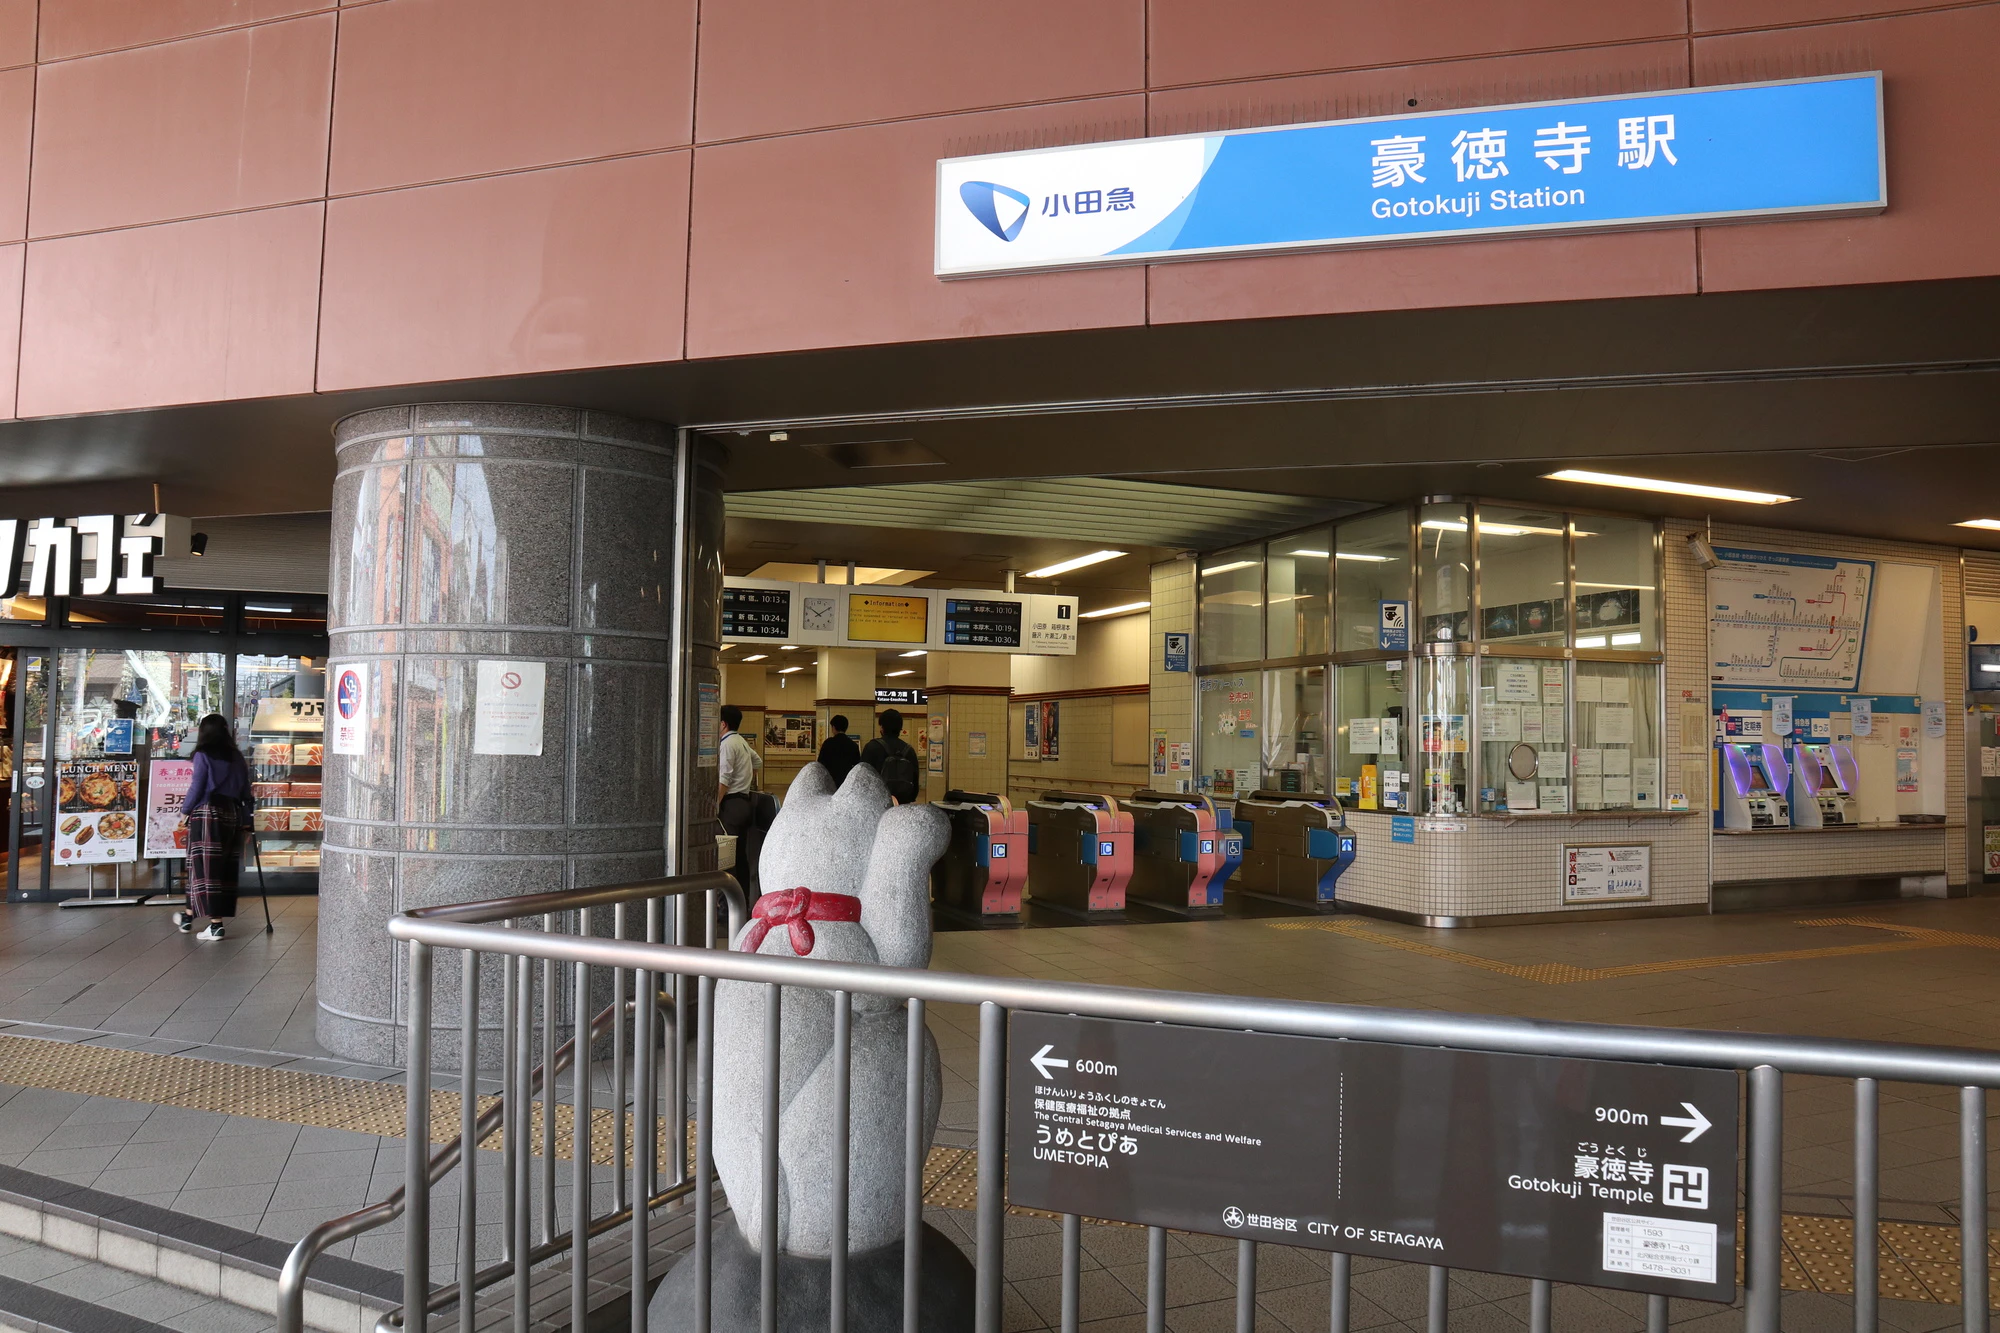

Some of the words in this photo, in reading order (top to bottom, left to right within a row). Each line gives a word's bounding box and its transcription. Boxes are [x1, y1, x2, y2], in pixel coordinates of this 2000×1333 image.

[1370, 114, 1678, 188] 豪徳寺駅
[1042, 187, 1136, 217] 小田急
[1371, 191, 1480, 219] Gotokuji
[1490, 187, 1585, 210] Station
[762, 595, 780, 603] 10:13
[761, 614, 780, 622] 10:24
[1061, 606, 1066, 618] 1
[761, 626, 780, 634] 10:34
[995, 624, 1012, 632] 10:19
[995, 636, 1012, 644] 10:30
[911, 690, 917, 704] 1
[1715, 719, 1721, 732] 1
[62, 765, 100, 774] LUNCH
[104, 764, 137, 773] MENU
[156, 806, 182, 814] チョコク
[993, 844, 1005, 857] IC
[1101, 842, 1112, 855] IC
[1201, 840, 1212, 853] IC
[1076, 1059, 1118, 1076] 600m
[1035, 1085, 1166, 1109] ほけんいりょうふくしのきょてん
[1034, 1098, 1131, 1121] 保健医療福祉の拠点
[1595, 1107, 1649, 1125] 900m
[1034, 1111, 1050, 1121] The
[1052, 1114, 1083, 1125] Central
[1086, 1117, 1125, 1130] Setagaya
[1127, 1122, 1163, 1135] Medical
[1165, 1126, 1202, 1139] Services
[1205, 1132, 1222, 1142] and
[1225, 1133, 1262, 1146] Welfare
[1036, 1124, 1139, 1156] うめとぴあ
[1577, 1141, 1599, 1153] ごう
[1605, 1144, 1626, 1156] とく
[1637, 1147, 1647, 1158] じ
[1033, 1147, 1109, 1169] UMETOPIA
[1574, 1154, 1654, 1185] 豪徳寺
[1508, 1174, 1582, 1199] Gotokuji
[1589, 1182, 1654, 1205] Temple
[1247, 1213, 1298, 1232] 世田谷区
[1307, 1221, 1339, 1237] CITY
[1344, 1226, 1364, 1239] OF
[1369, 1229, 1444, 1250] SETAGAYA
[1643, 1228, 1663, 1238] 1593
